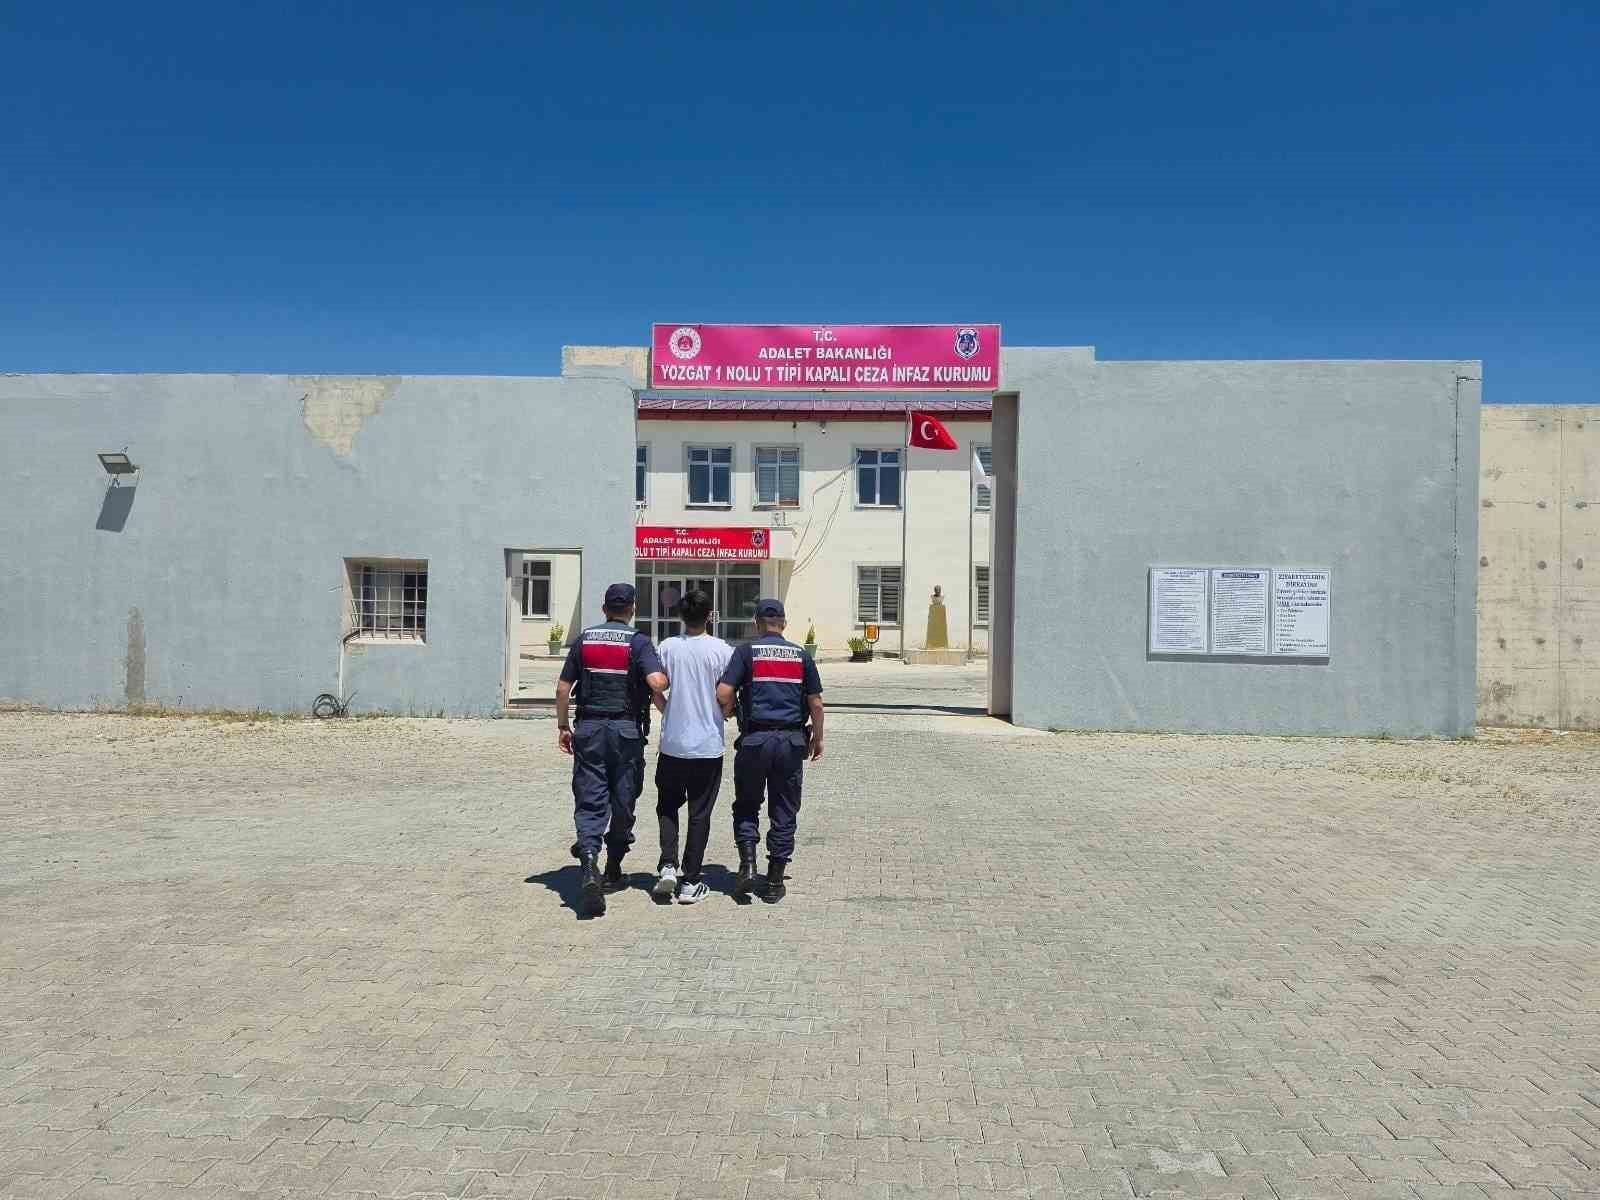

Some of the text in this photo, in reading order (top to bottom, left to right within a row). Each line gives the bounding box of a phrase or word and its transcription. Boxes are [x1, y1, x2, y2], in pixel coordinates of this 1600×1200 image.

[812, 329, 837, 342] T.C.
[758, 344, 892, 360] ADALET BAKANLIĞI
[661, 363, 992, 382] YOZGAT 1 NOLU T TİPİ KAPALI CEZA İNFAZ KURUMU
[676, 537, 721, 545] BAKANLIĞI
[634, 545, 769, 558] OLU T TİPİ KAPALI CEZA İNFAZ KURUMU
